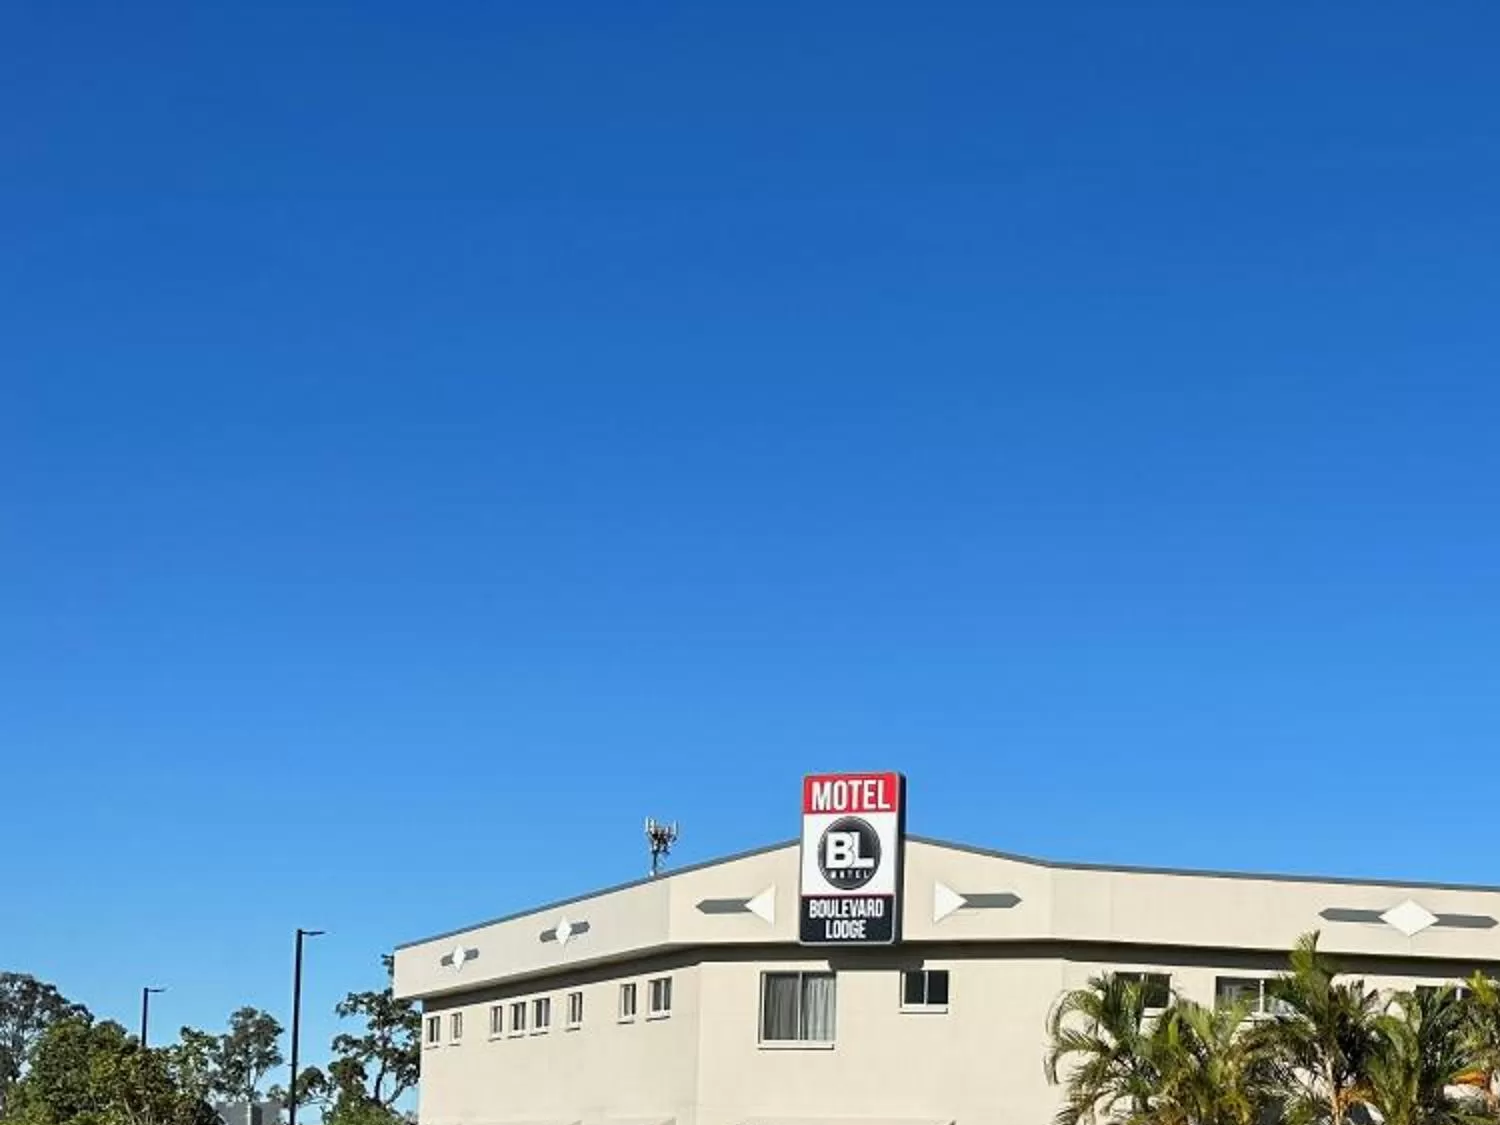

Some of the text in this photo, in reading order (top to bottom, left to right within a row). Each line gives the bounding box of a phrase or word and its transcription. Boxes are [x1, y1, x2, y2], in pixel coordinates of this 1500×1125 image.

[811, 780, 891, 811] MOTEL
[825, 831, 875, 869] BL
[809, 898, 884, 918] BOULEVARD
[825, 920, 867, 939] LODGE
